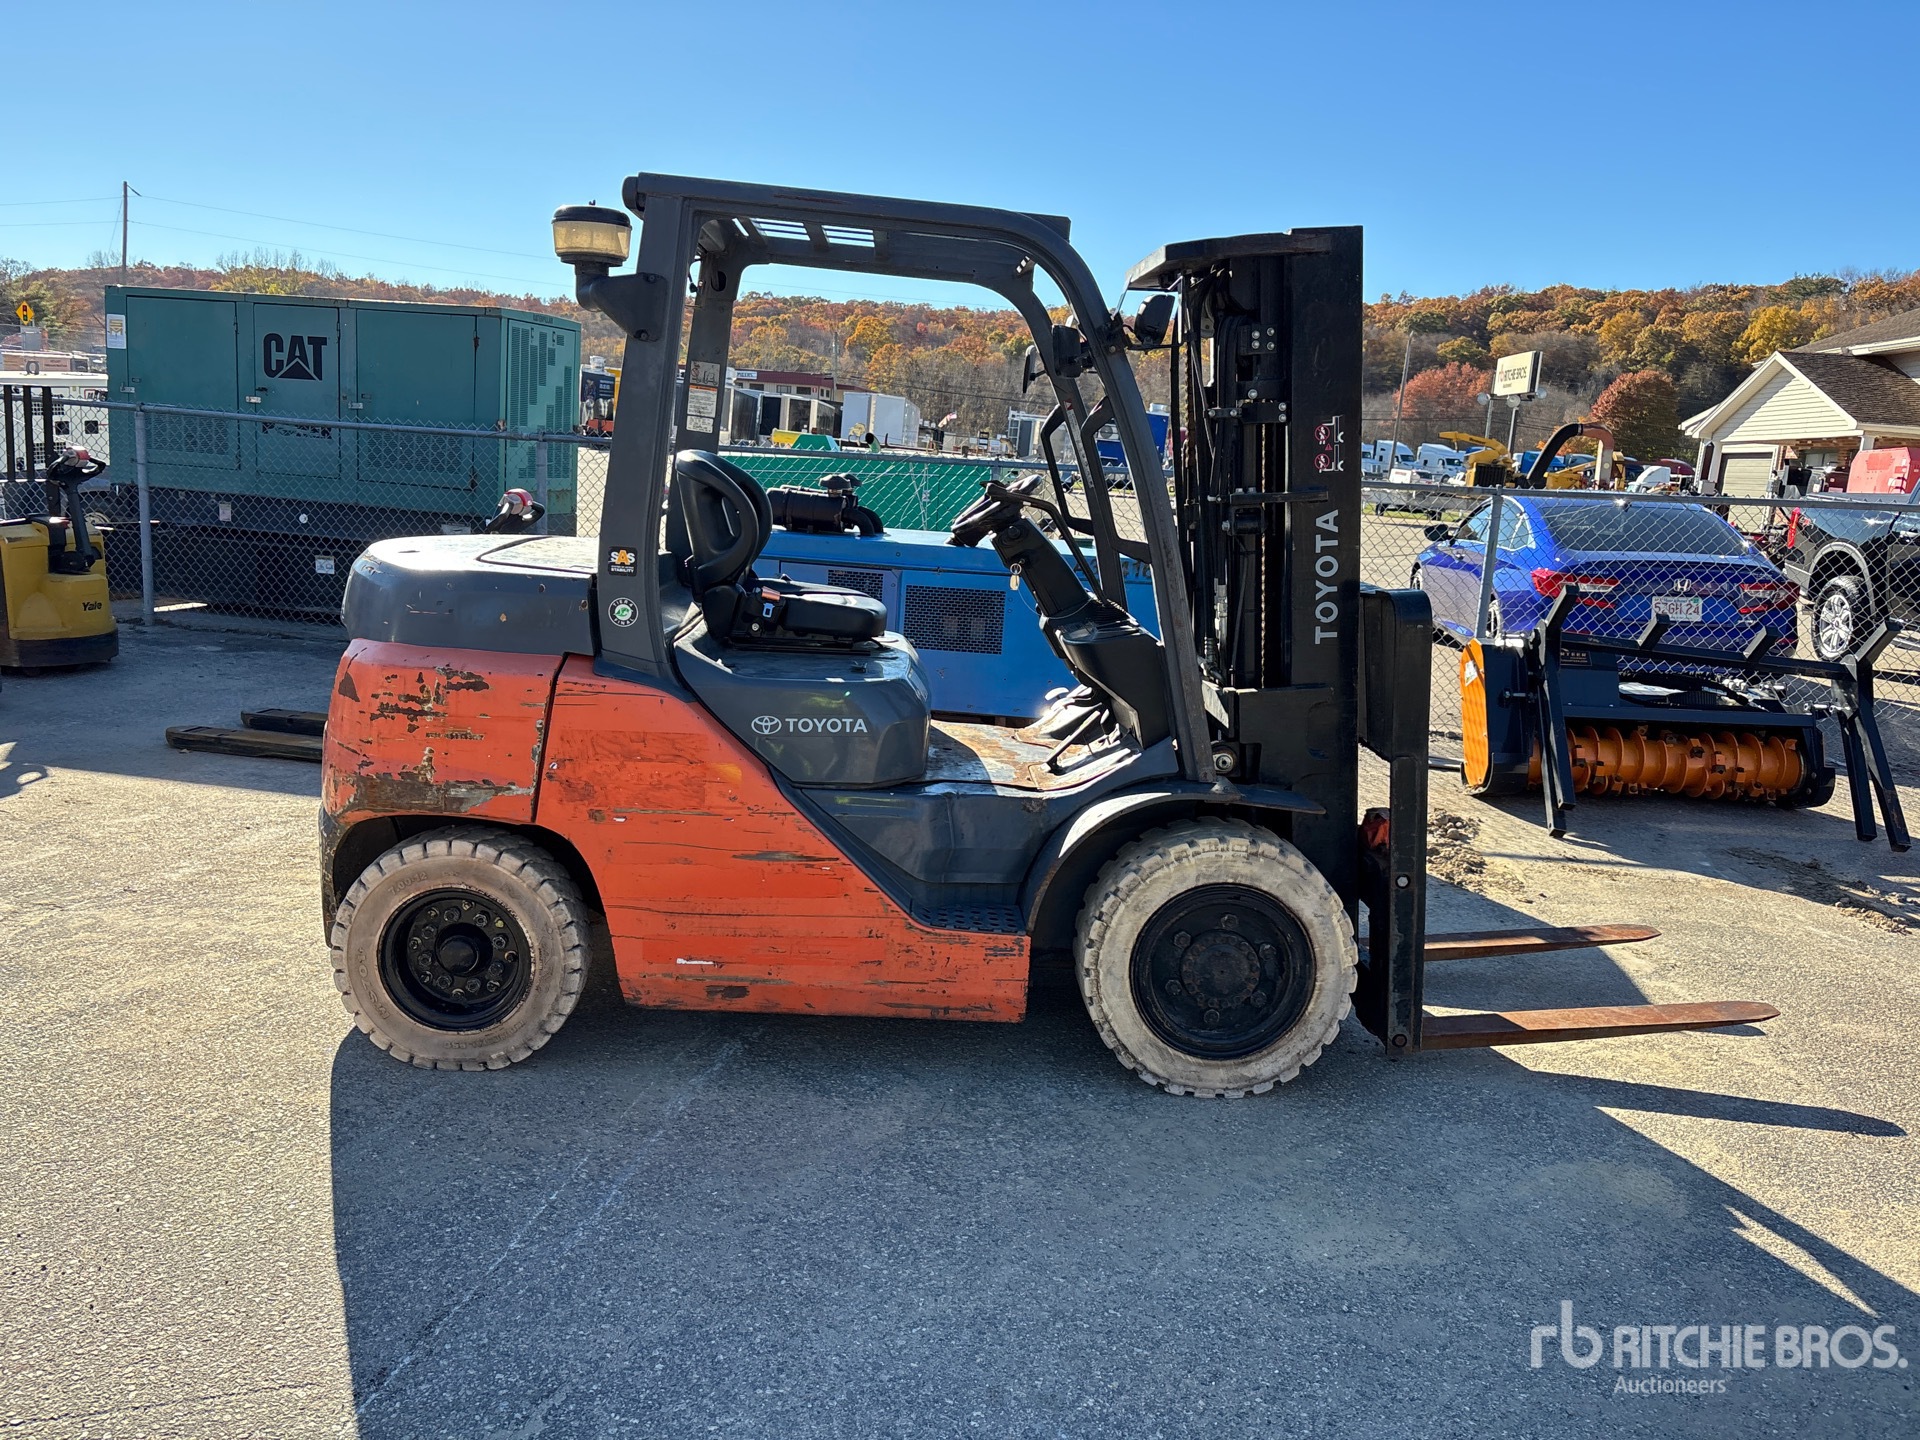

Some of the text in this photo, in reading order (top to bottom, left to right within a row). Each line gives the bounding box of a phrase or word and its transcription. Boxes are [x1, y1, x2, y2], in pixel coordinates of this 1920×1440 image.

[263, 333, 328, 381] CAT
[610, 549, 636, 565] SAS
[1315, 509, 1339, 645] TOYOTA
[82, 601, 102, 611] Yale
[785, 718, 868, 733] TOYOTA
